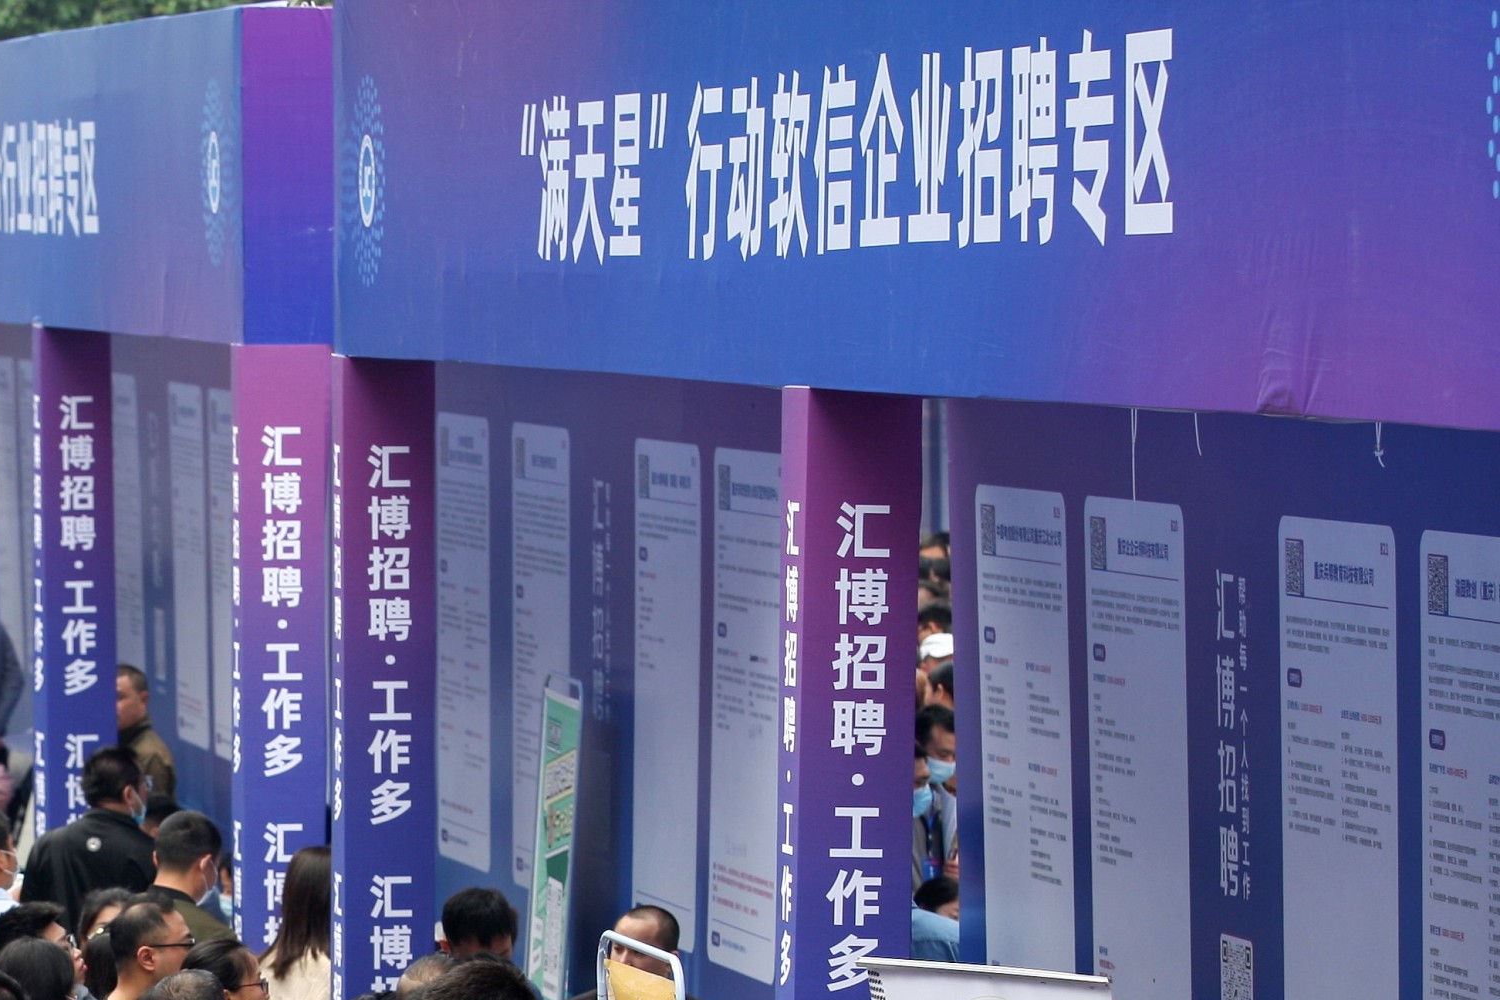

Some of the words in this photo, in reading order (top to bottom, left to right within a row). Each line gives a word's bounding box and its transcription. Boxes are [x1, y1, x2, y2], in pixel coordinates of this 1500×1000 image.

[60, 395, 98, 696] 汇博招聘·工作多
[262, 425, 303, 777] 汇博招聘·工作多
[368, 444, 412, 825] 汇博招聘·工作多
[779, 500, 801, 986] 汇博招聘·工作多
[826, 501, 891, 994] 汇博招聘·工作多
[1215, 568, 1238, 898] 汇博招聘
